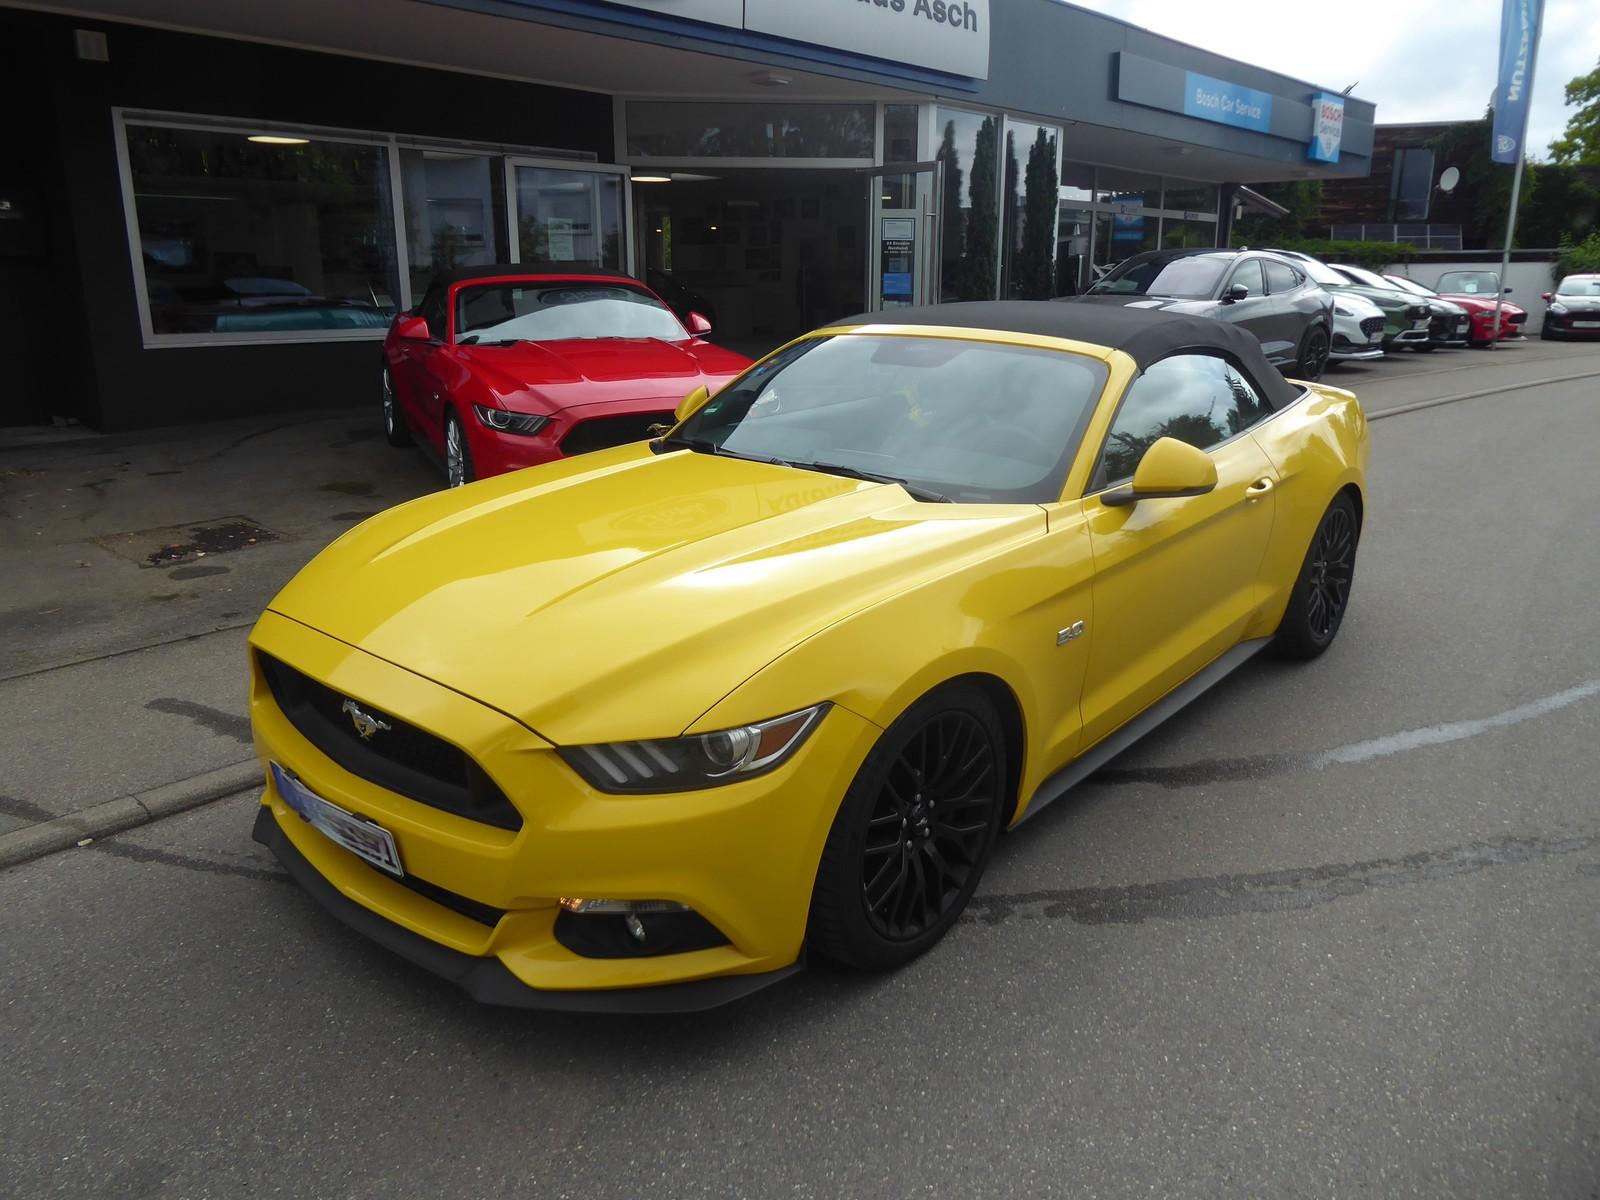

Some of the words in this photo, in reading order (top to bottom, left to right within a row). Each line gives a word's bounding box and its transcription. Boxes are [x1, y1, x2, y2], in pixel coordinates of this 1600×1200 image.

[913, 0, 978, 32] Asch
[1196, 88, 1219, 108] Bosch
[1221, 95, 1234, 112] Car
[1235, 99, 1261, 120] Service
[1321, 103, 1343, 122] BOSCH
